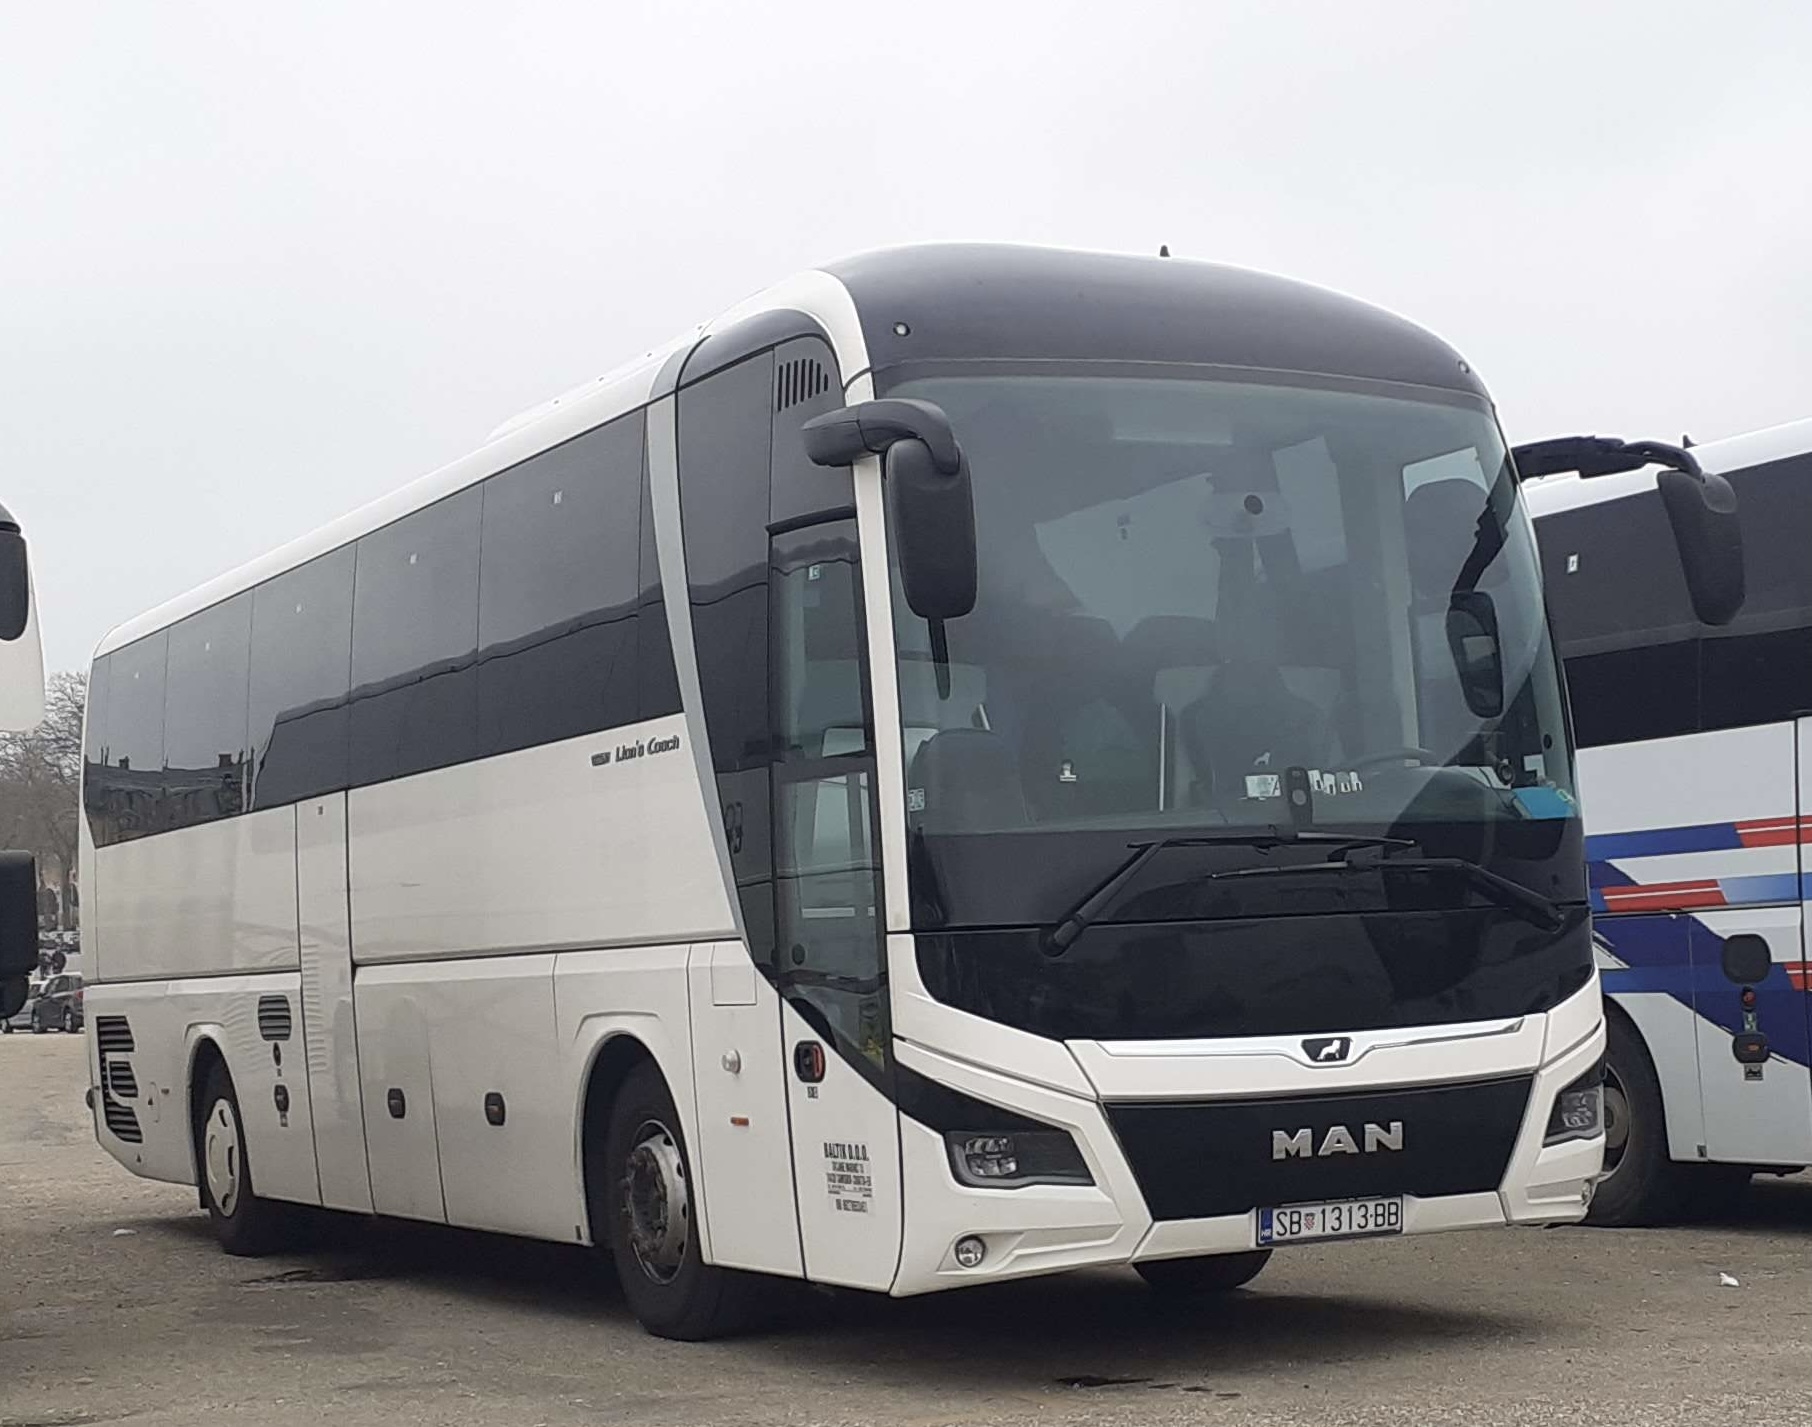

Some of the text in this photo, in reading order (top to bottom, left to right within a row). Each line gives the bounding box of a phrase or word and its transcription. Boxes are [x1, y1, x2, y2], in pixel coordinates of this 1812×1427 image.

[647, 735, 680, 755] Coach
[1271, 1120, 1404, 1160] MAN
[1276, 1210, 1302, 1237] SB
